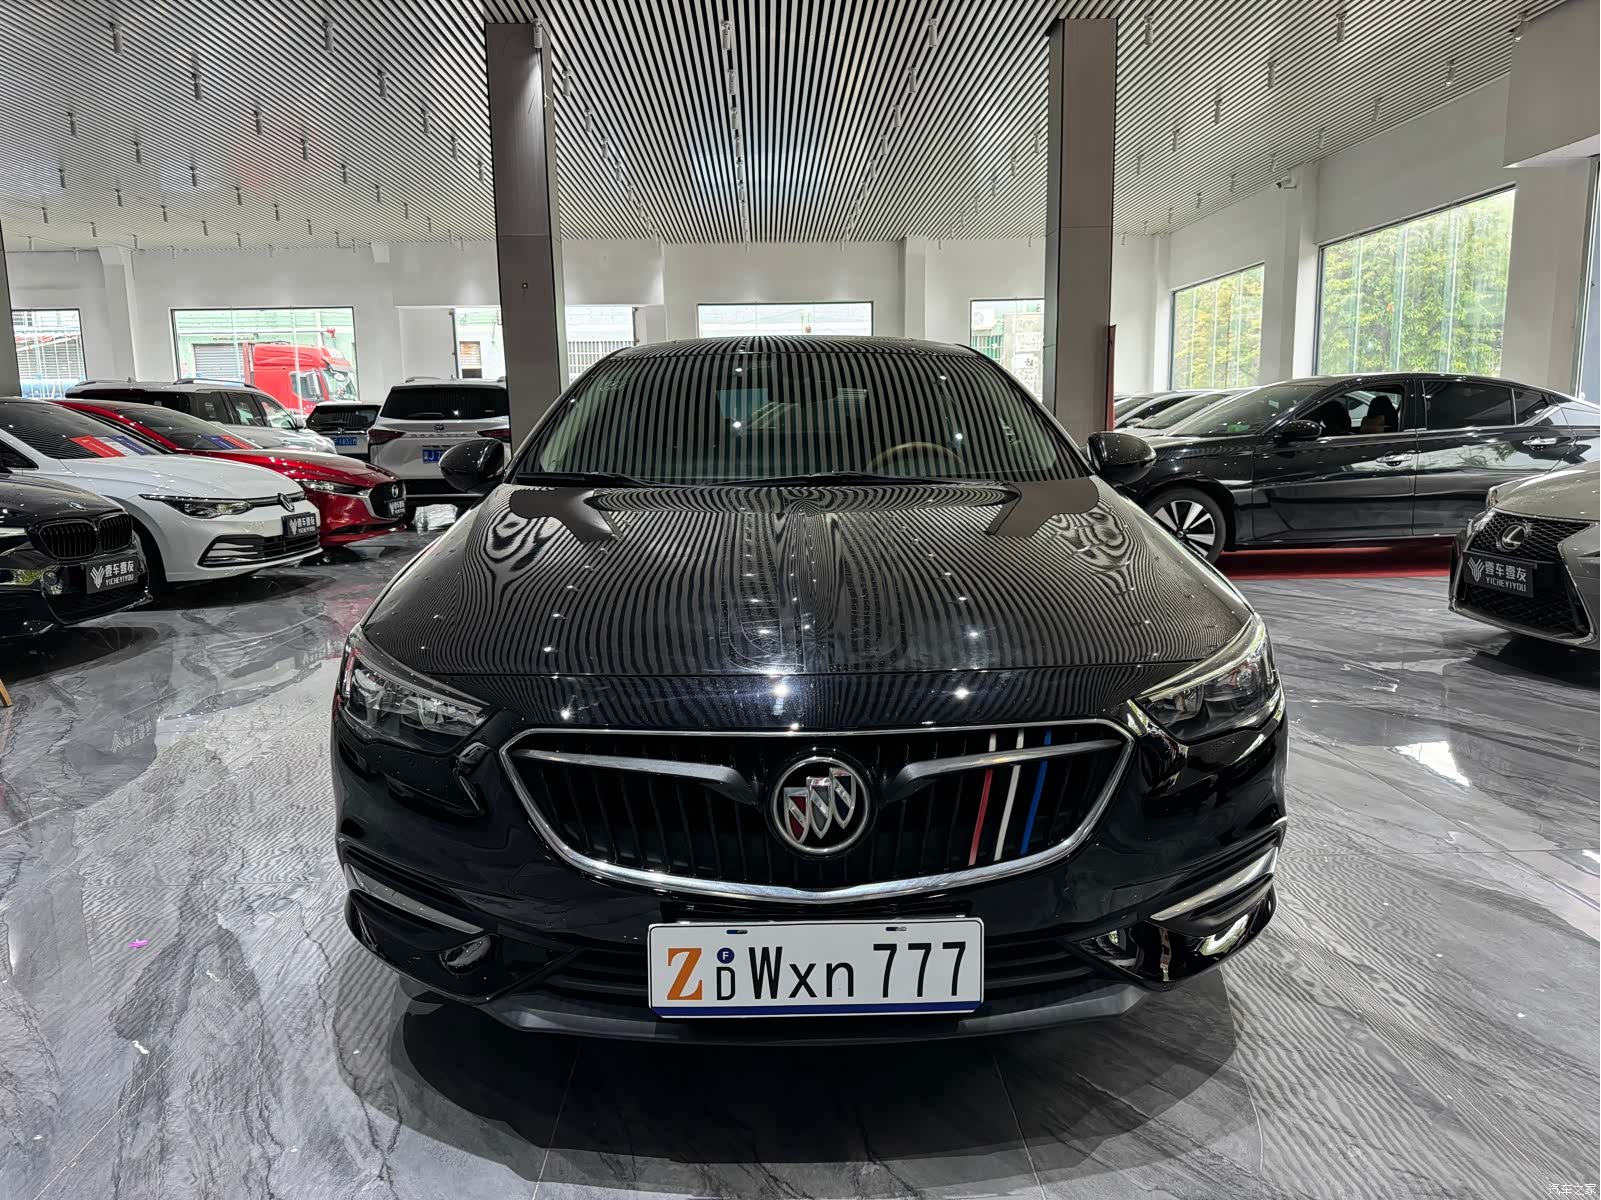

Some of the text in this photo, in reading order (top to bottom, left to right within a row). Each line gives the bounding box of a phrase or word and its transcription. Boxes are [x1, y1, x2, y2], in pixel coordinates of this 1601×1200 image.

[105, 560, 134, 577] 壹车壹友
[1484, 560, 1527, 583] 壹车壹友
[1485, 576, 1527, 592] YICHEYIYOU
[666, 947, 703, 1001] Z
[748, 946, 855, 999] Wxn
[873, 941, 967, 998] 777
